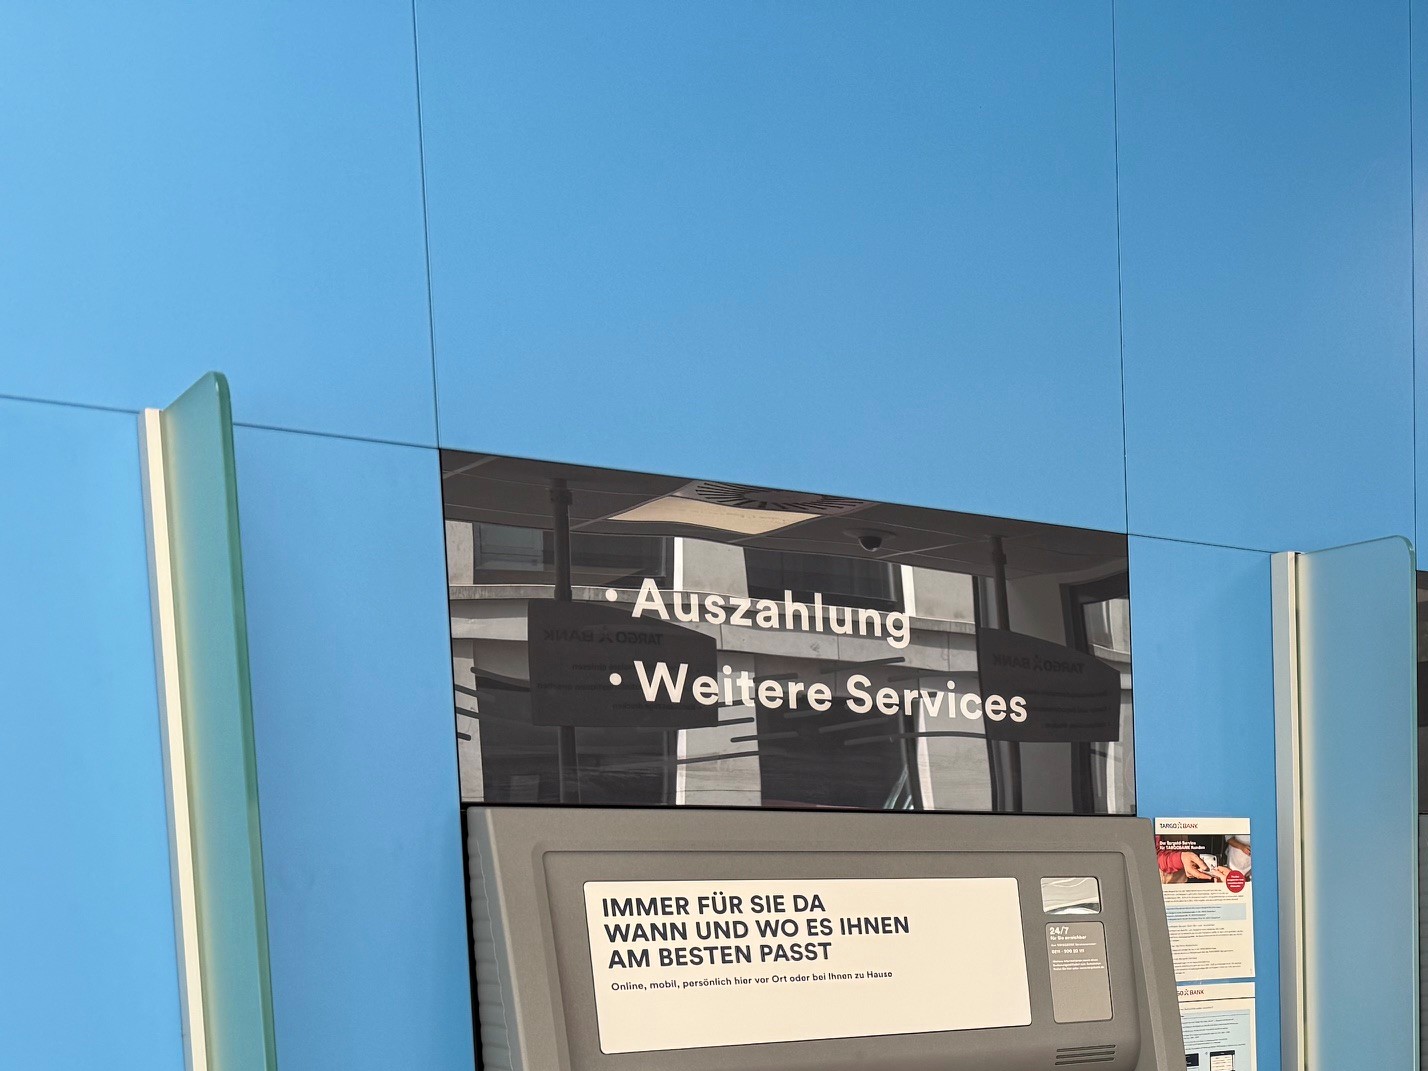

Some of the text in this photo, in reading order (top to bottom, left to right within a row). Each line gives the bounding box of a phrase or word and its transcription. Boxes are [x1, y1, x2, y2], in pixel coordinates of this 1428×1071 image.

[632, 578, 911, 649] Auszahlung
[633, 660, 1028, 723] Weitere Services
[602, 892, 826, 918] IMMER FÜR SIE DA
[604, 916, 910, 943] WANN UND WO ES IHNEN
[1049, 926, 1069, 935] 24/7
[608, 942, 832, 969] AM BESTEN PASST
[611, 982, 647, 991] Online,
[649, 979, 680, 990] mobil,
[683, 977, 732, 989] persönlich
[734, 976, 752, 985] hier
[754, 976, 769, 984] vor
[772, 974, 787, 983] Ort
[789, 974, 809, 982] oder
[812, 972, 826, 981] bei
[828, 972, 852, 980] Ihnen
[867, 970, 893, 978] Hause
